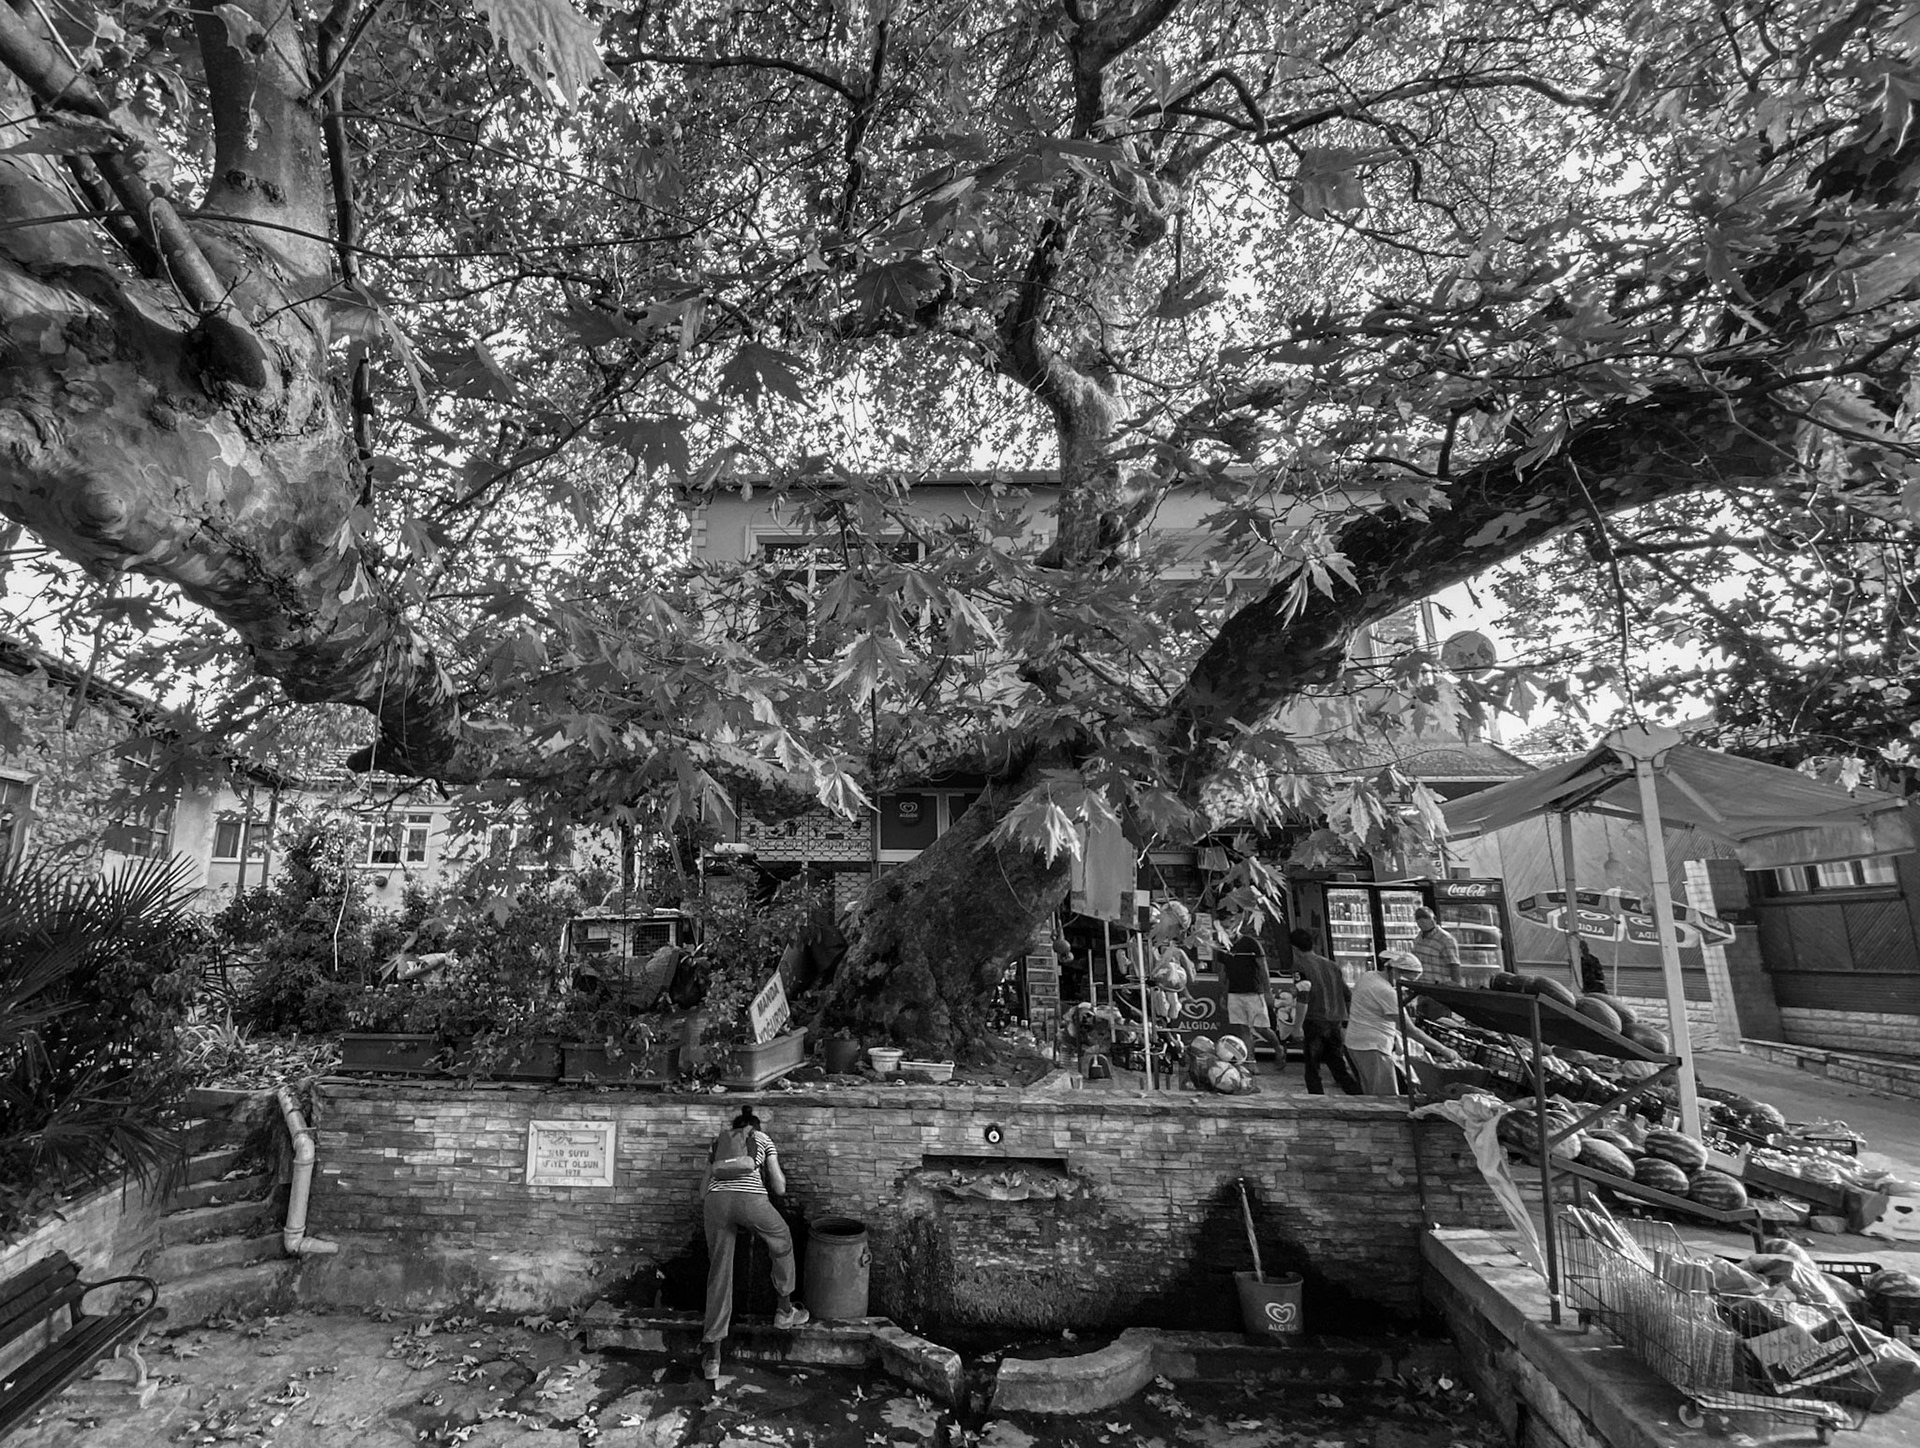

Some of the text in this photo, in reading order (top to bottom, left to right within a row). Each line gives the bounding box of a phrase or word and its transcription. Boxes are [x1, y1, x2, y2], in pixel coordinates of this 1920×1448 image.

[757, 981, 780, 1018] MANDA
[568, 1149, 590, 1158] SUYU
[571, 1160, 599, 1169] OLSUN
[1268, 1323, 1298, 1331] ALGDA
